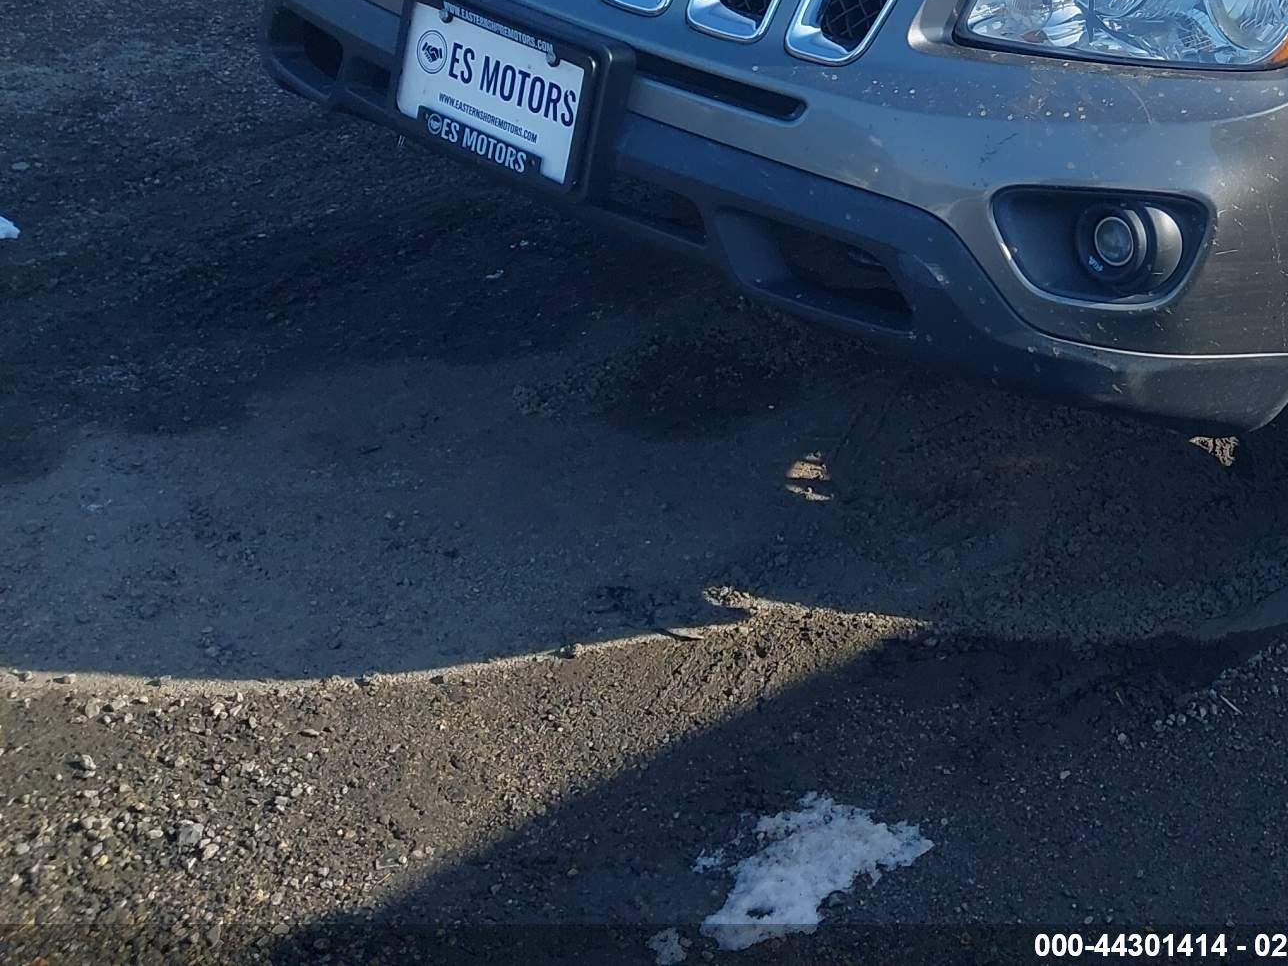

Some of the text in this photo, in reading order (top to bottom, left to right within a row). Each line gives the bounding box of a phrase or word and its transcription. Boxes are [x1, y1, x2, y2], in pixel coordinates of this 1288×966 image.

[448, 42, 577, 127] ES MOTORS
[438, 92, 538, 144] WWW.EASTERNSHOREMOTORS.COM
[440, 118, 527, 173] ES MOTORS
